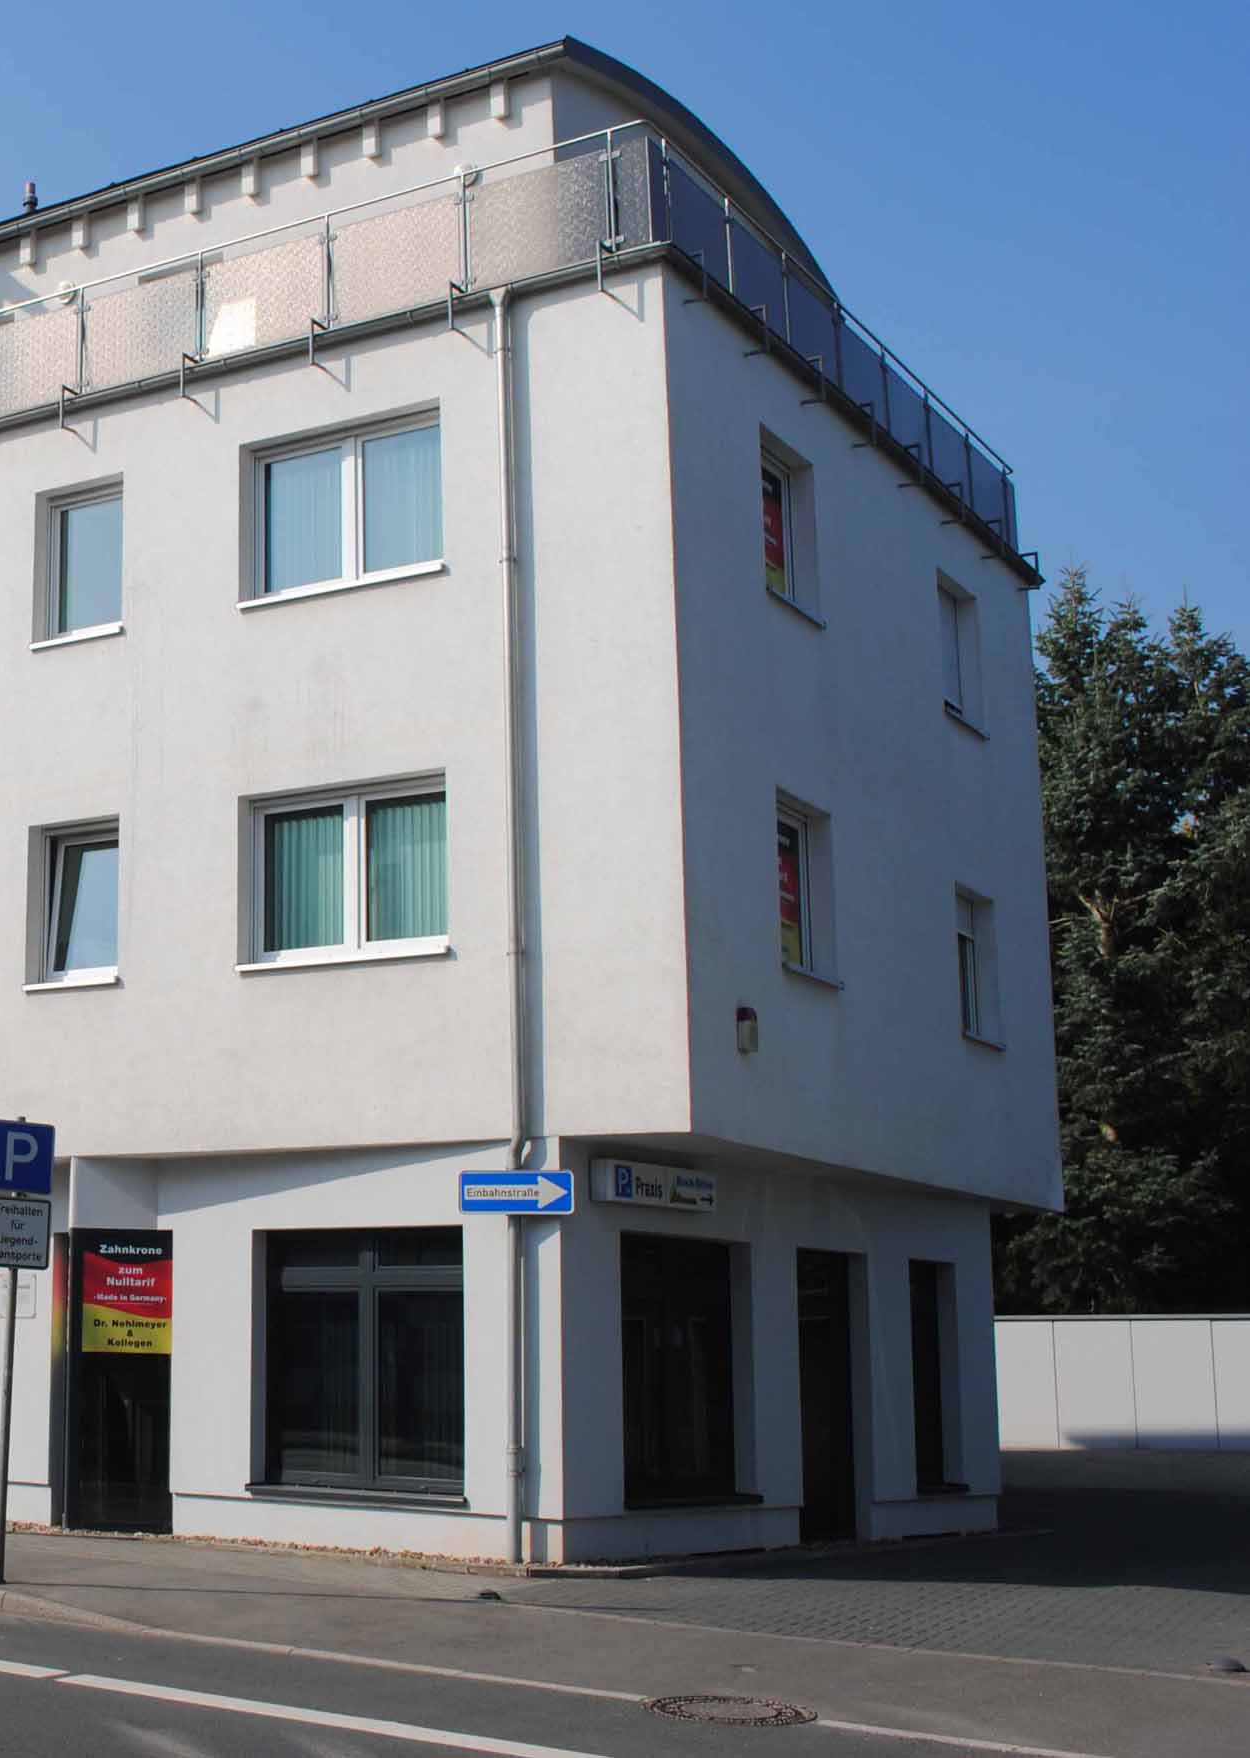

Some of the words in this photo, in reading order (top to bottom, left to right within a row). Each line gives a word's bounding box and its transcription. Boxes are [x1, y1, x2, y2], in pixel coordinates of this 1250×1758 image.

[5, 1131, 38, 1181] P
[617, 1167, 630, 1194] P
[466, 1187, 540, 1198] Einbahnstraße
[635, 1175, 663, 1199] Praxis
[11, 1219, 26, 1231] für
[99, 1243, 163, 1255] Zahnkrone
[118, 1266, 143, 1275] zum
[106, 1276, 156, 1287] Nulltarif
[93, 1319, 108, 1328] Dr.
[107, 1338, 153, 1348] Kollegen
